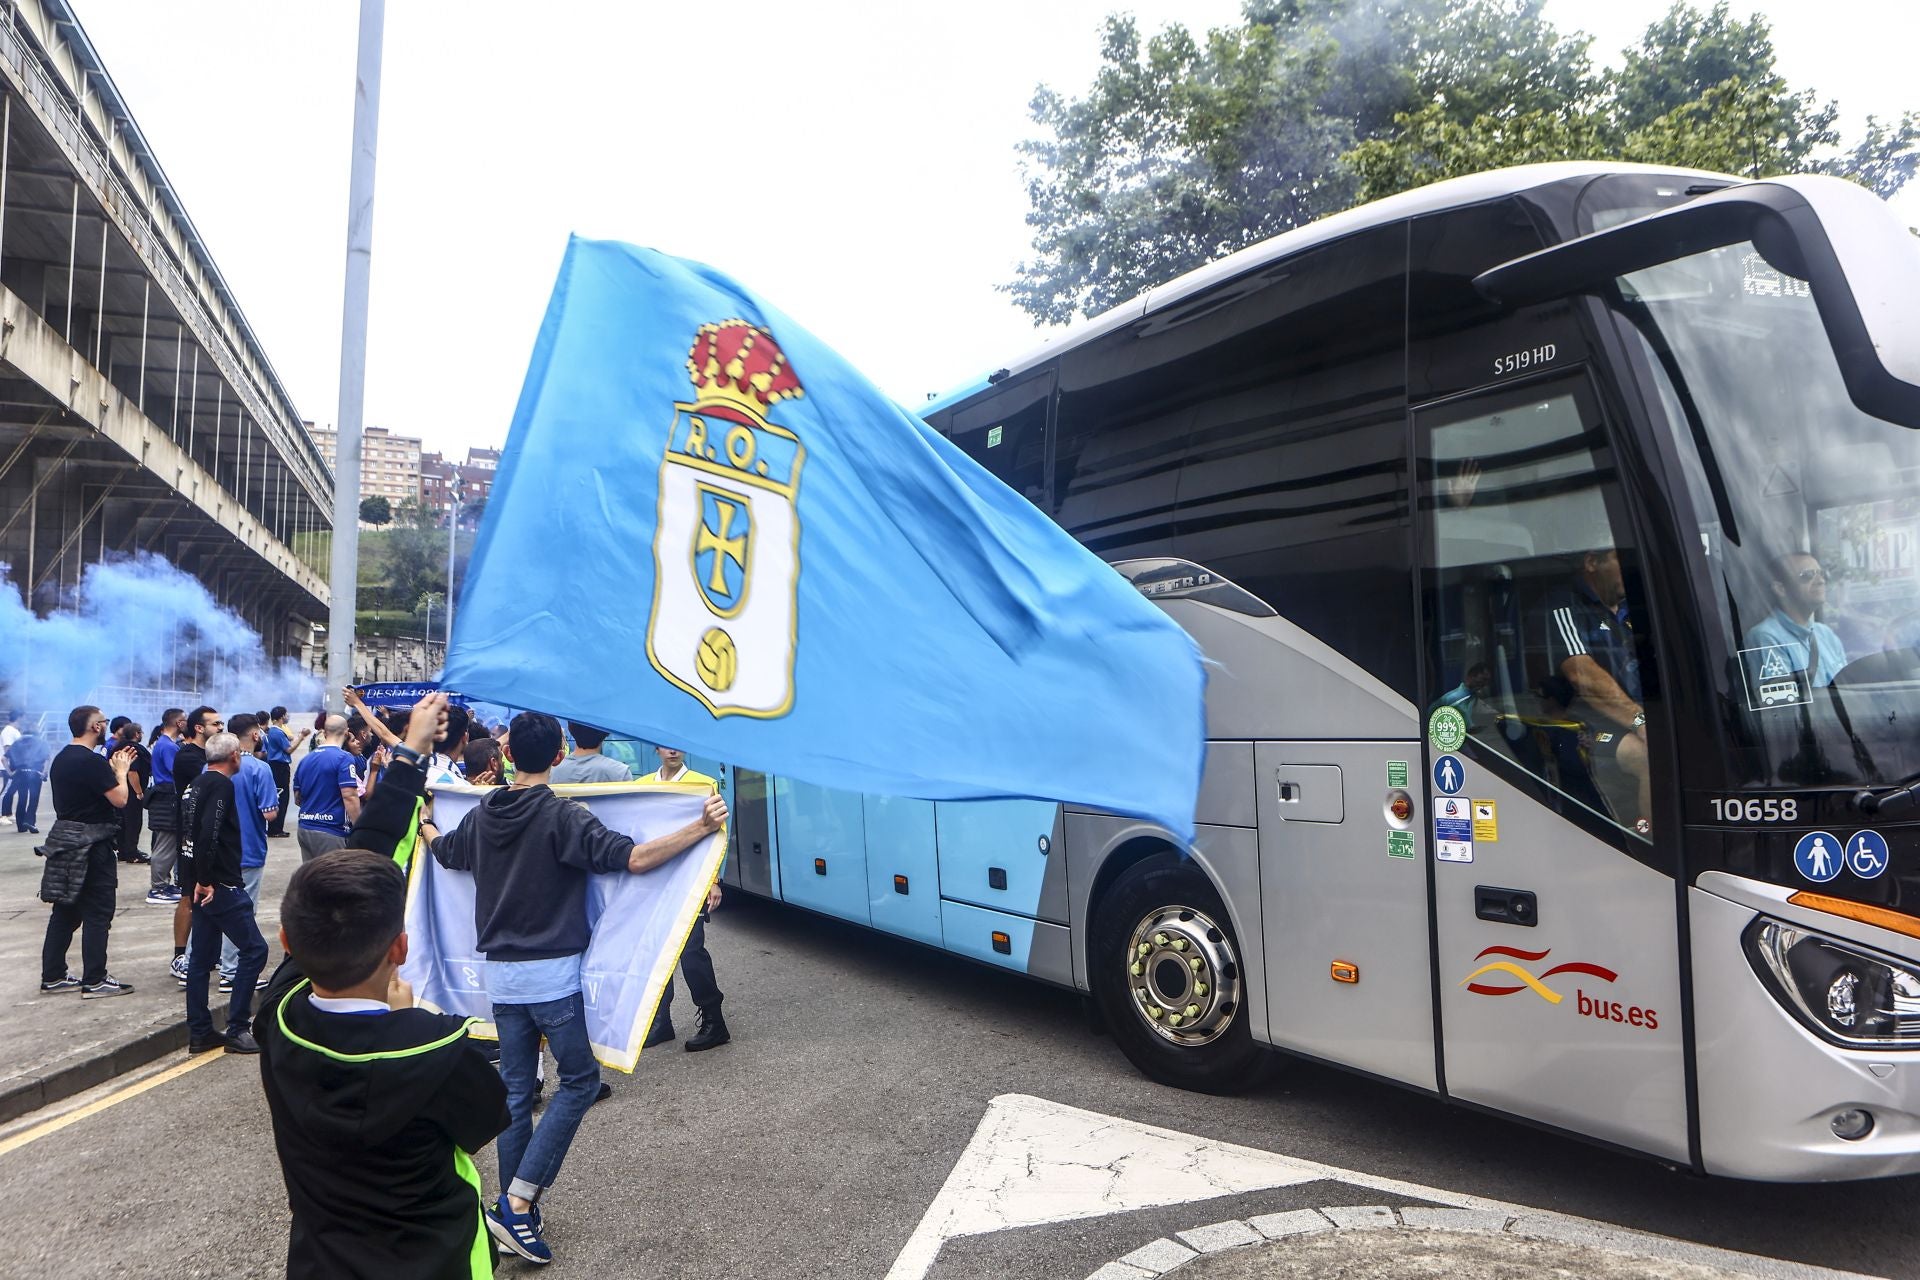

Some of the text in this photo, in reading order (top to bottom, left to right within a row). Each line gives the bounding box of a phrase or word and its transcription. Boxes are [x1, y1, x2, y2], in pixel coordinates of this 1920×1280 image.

[1494, 344, 1556, 375] S 519 HD
[1142, 573, 1210, 593] SETRA
[1437, 721, 1457, 732] 99%
[1710, 798, 1798, 822] 10658
[1577, 989, 1658, 1030] bus.es
